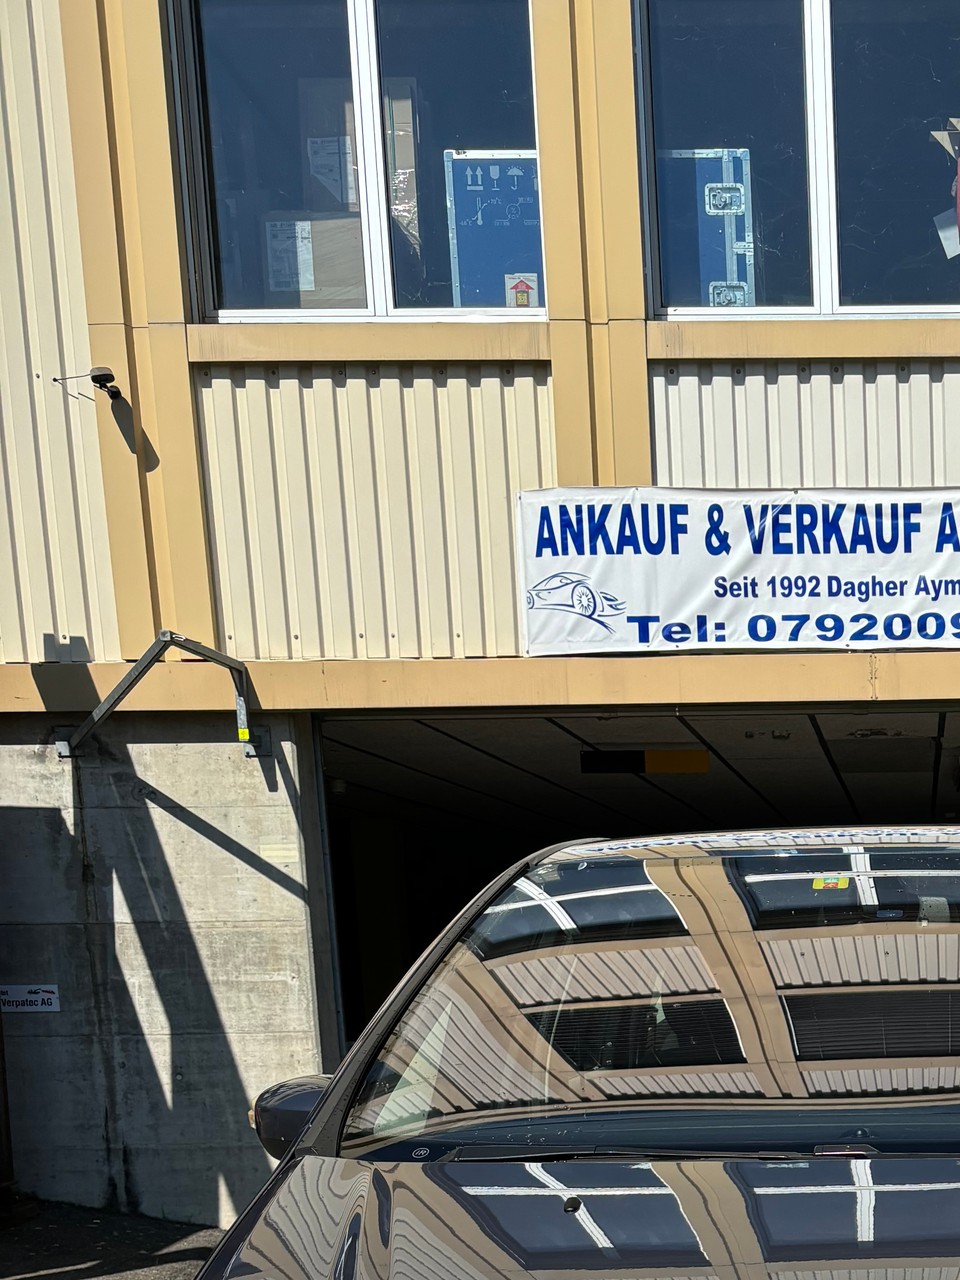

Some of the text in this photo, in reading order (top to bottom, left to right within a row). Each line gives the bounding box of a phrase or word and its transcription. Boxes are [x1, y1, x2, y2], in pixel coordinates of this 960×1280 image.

[535, 503, 689, 558] ANKAUF
[705, 503, 732, 555] &
[744, 502, 921, 555] VERKAUF
[714, 575, 759, 599] Seit
[766, 575, 821, 598] 1992
[827, 576, 908, 602] Dagher
[626, 614, 726, 643] Tel:
[0, 998, 53, 1008] Verpatec AG
